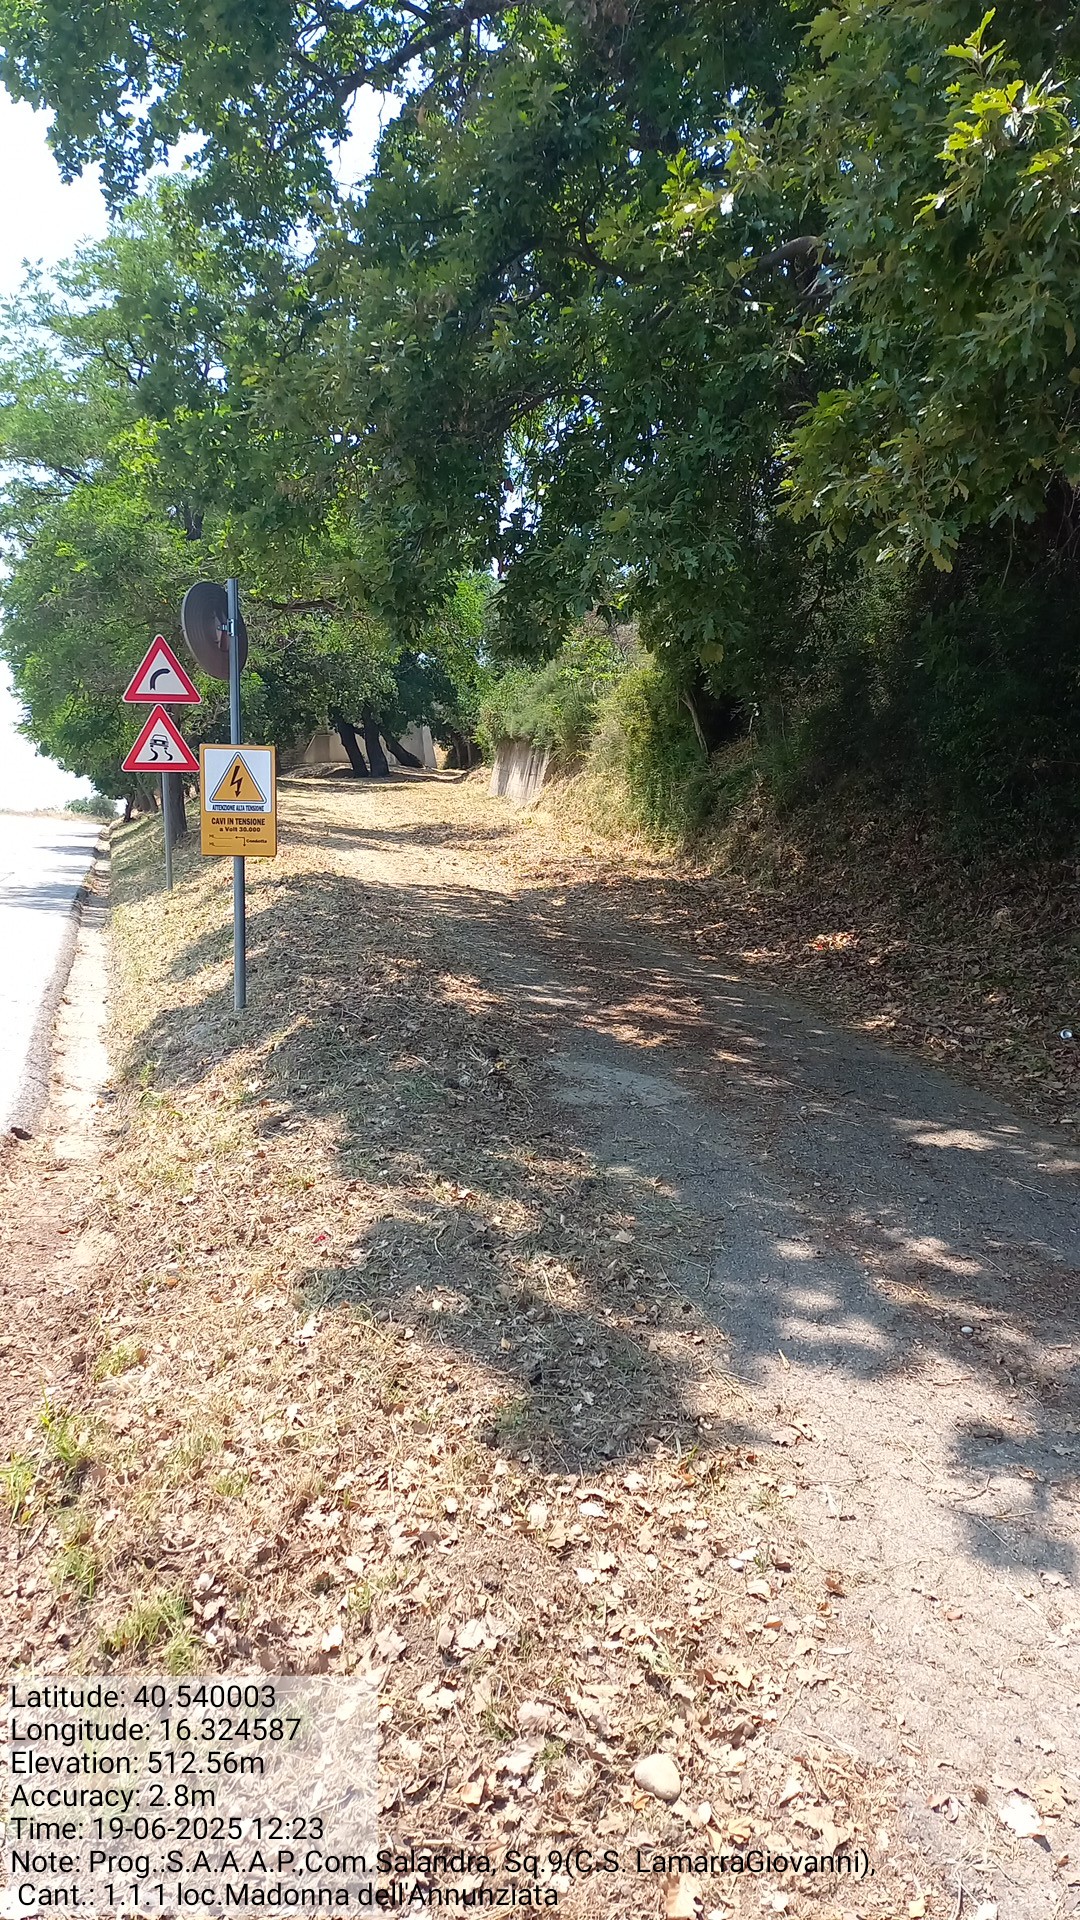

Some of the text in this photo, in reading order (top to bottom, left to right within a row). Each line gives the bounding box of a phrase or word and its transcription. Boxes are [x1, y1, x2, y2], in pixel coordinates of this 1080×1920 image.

[211, 817, 266, 826] CAVI IN TENSIONE
